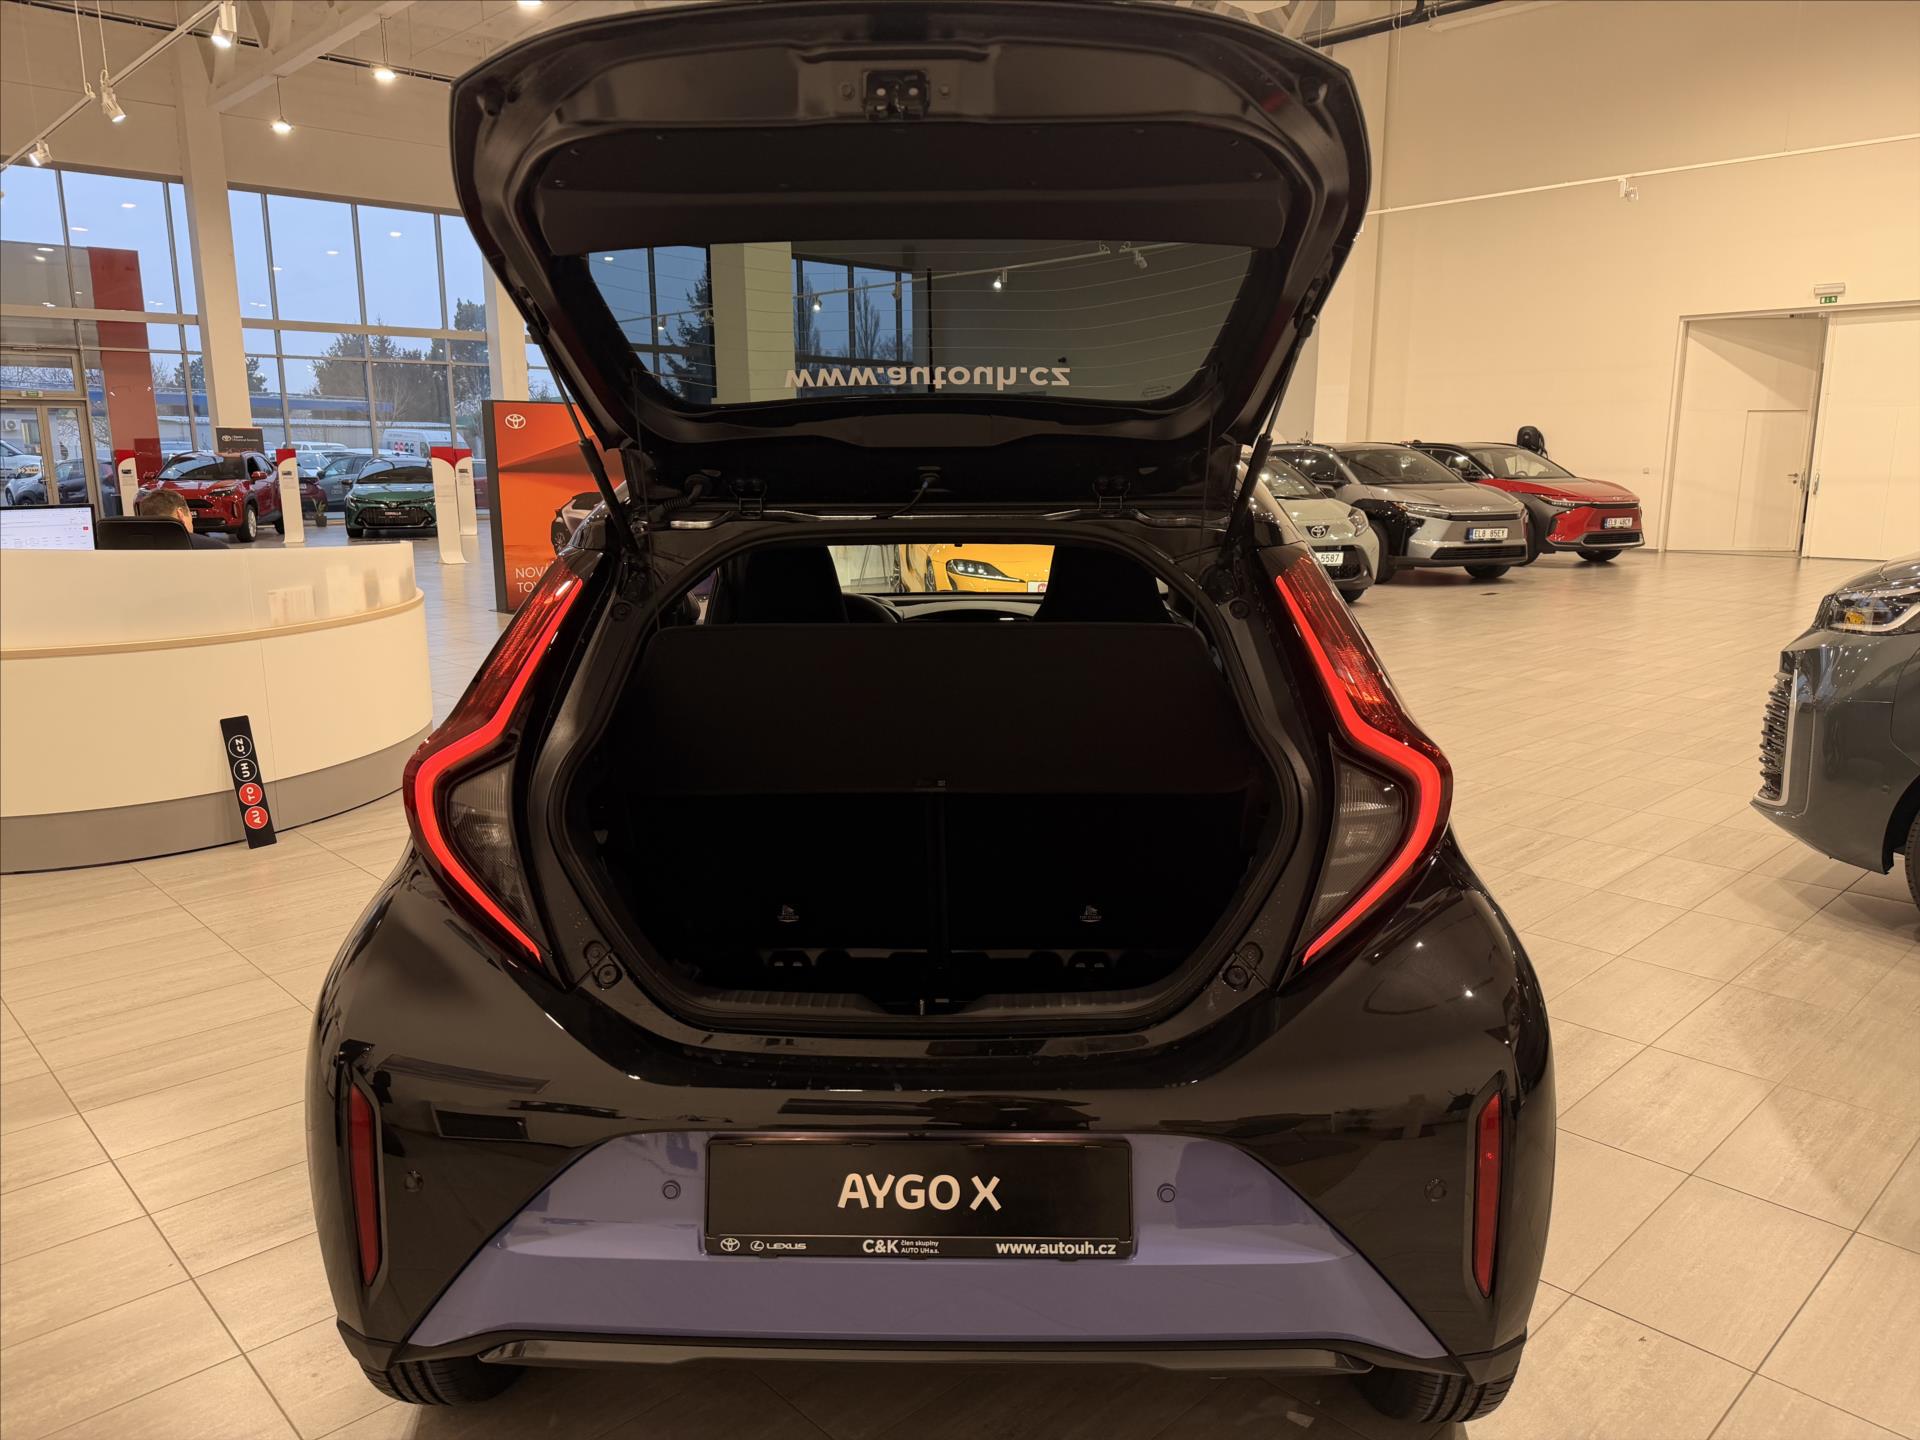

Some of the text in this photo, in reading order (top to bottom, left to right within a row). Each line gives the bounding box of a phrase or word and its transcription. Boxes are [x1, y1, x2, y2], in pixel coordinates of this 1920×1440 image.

[837, 1172, 1002, 1212] AYGO X
[766, 1242, 807, 1250] LEXUS
[862, 1238, 900, 1254] C&K
[995, 1240, 1117, 1255] www.autouh.cz
